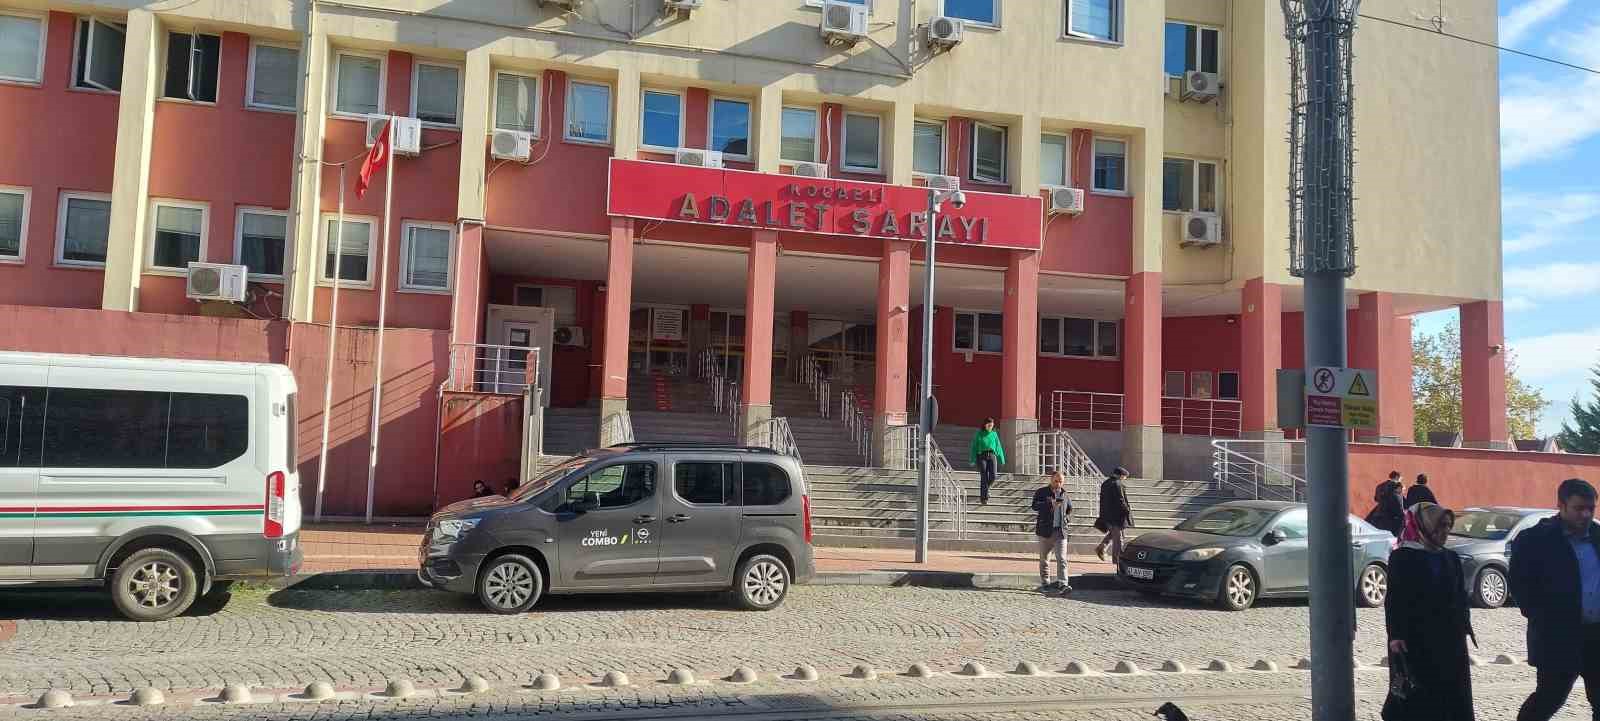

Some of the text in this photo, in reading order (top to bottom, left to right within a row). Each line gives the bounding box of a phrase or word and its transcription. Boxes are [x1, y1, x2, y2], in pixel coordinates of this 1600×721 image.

[679, 192, 990, 241] ADALET SARAYI
[581, 536, 618, 546] COMBO
